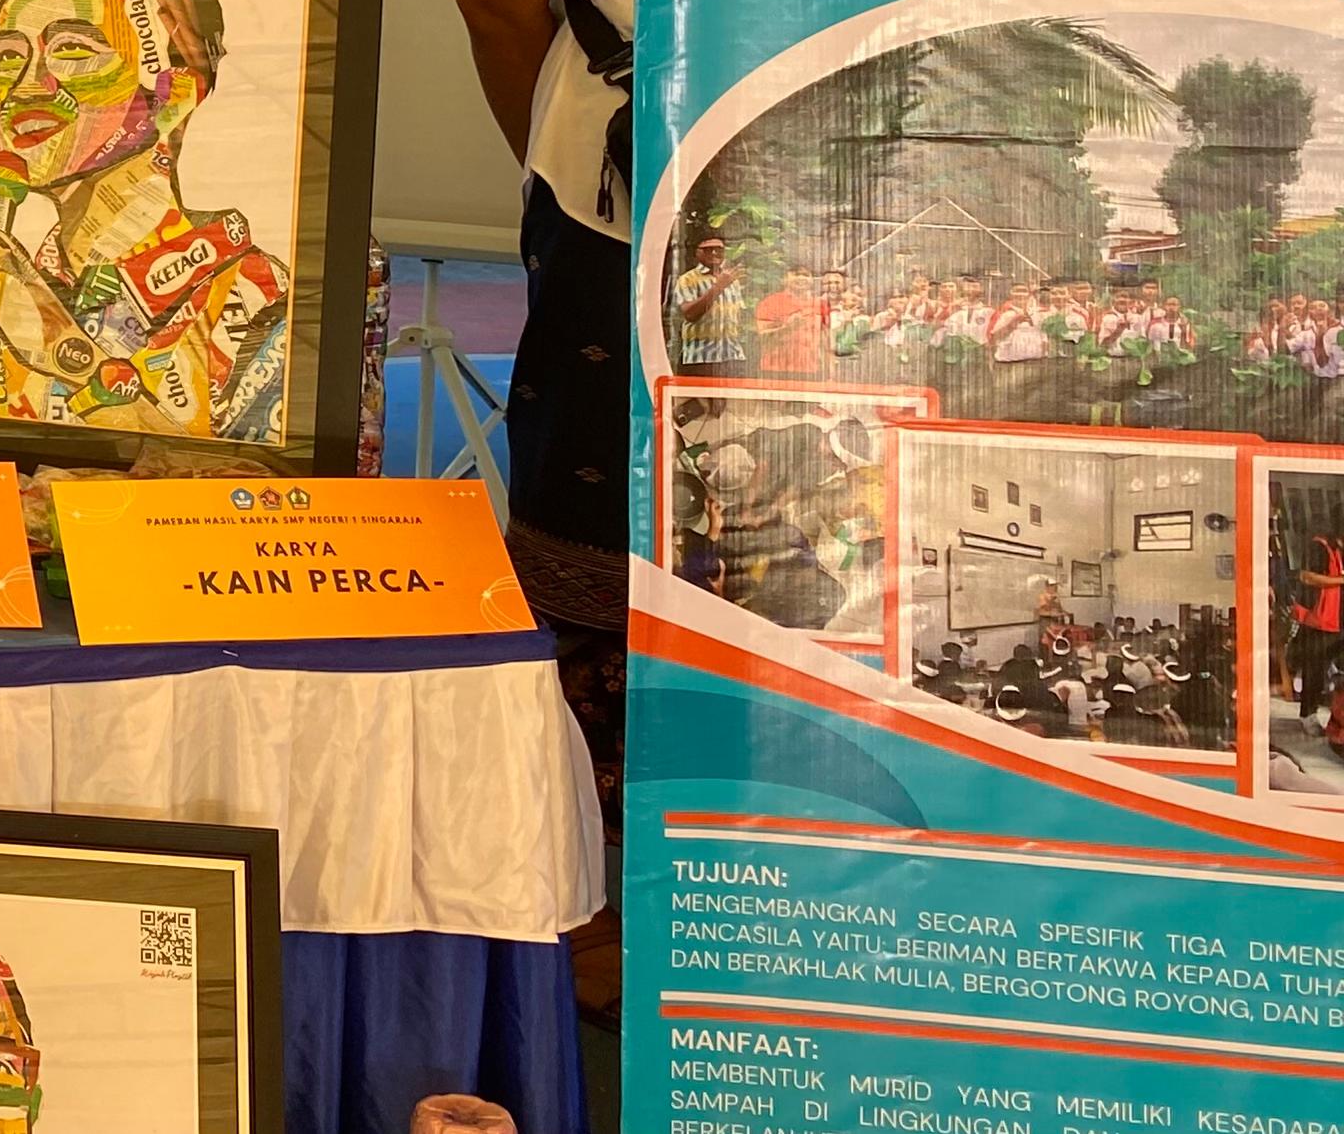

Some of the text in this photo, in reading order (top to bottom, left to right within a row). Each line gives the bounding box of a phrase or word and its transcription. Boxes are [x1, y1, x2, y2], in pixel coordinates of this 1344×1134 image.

[150, 244, 209, 290] KETAGI
[146, 518, 200, 526] PAMERAN
[205, 517, 236, 525] HASIL
[241, 517, 278, 525] KARYA
[283, 516, 304, 525] SMP
[309, 516, 348, 524] NEGERI
[361, 516, 422, 524] SINGARAJA
[256, 541, 337, 557] KARYA
[672, 861, 788, 888] TUJUAN:
[672, 893, 896, 927] MENGEMBANGKAN
[918, 912, 1017, 938] SECARA
[1040, 923, 1143, 950] SPESIFIK
[1167, 934, 1226, 957] TIGA
[672, 921, 802, 948] PANCASILA
[813, 930, 887, 955] YAITU:
[897, 939, 1005, 966] BERIMAN
[1017, 948, 1156, 980] BERTAKWA
[1167, 964, 1270, 991] KEPADA
[672, 949, 719, 969] DAN
[728, 953, 866, 981] BERAKHLAK
[875, 965, 955, 992] MULIA,
[964, 974, 1126, 1007] BERGOTONG
[1136, 990, 1253, 1021] ROYONG,
[1264, 1002, 1319, 1025] DAN
[671, 1028, 818, 1060] MANFAAT:
[671, 1061, 825, 1090] MEMBENTUK
[850, 1076, 931, 1101] MURID
[957, 1085, 1031, 1112] YANG
[1057, 1095, 1171, 1126] MEMILIKI
[671, 1089, 774, 1117] SAMPAH
[804, 1101, 829, 1122] DI
[860, 1105, 1030, 1134] LINGKUNGAN
